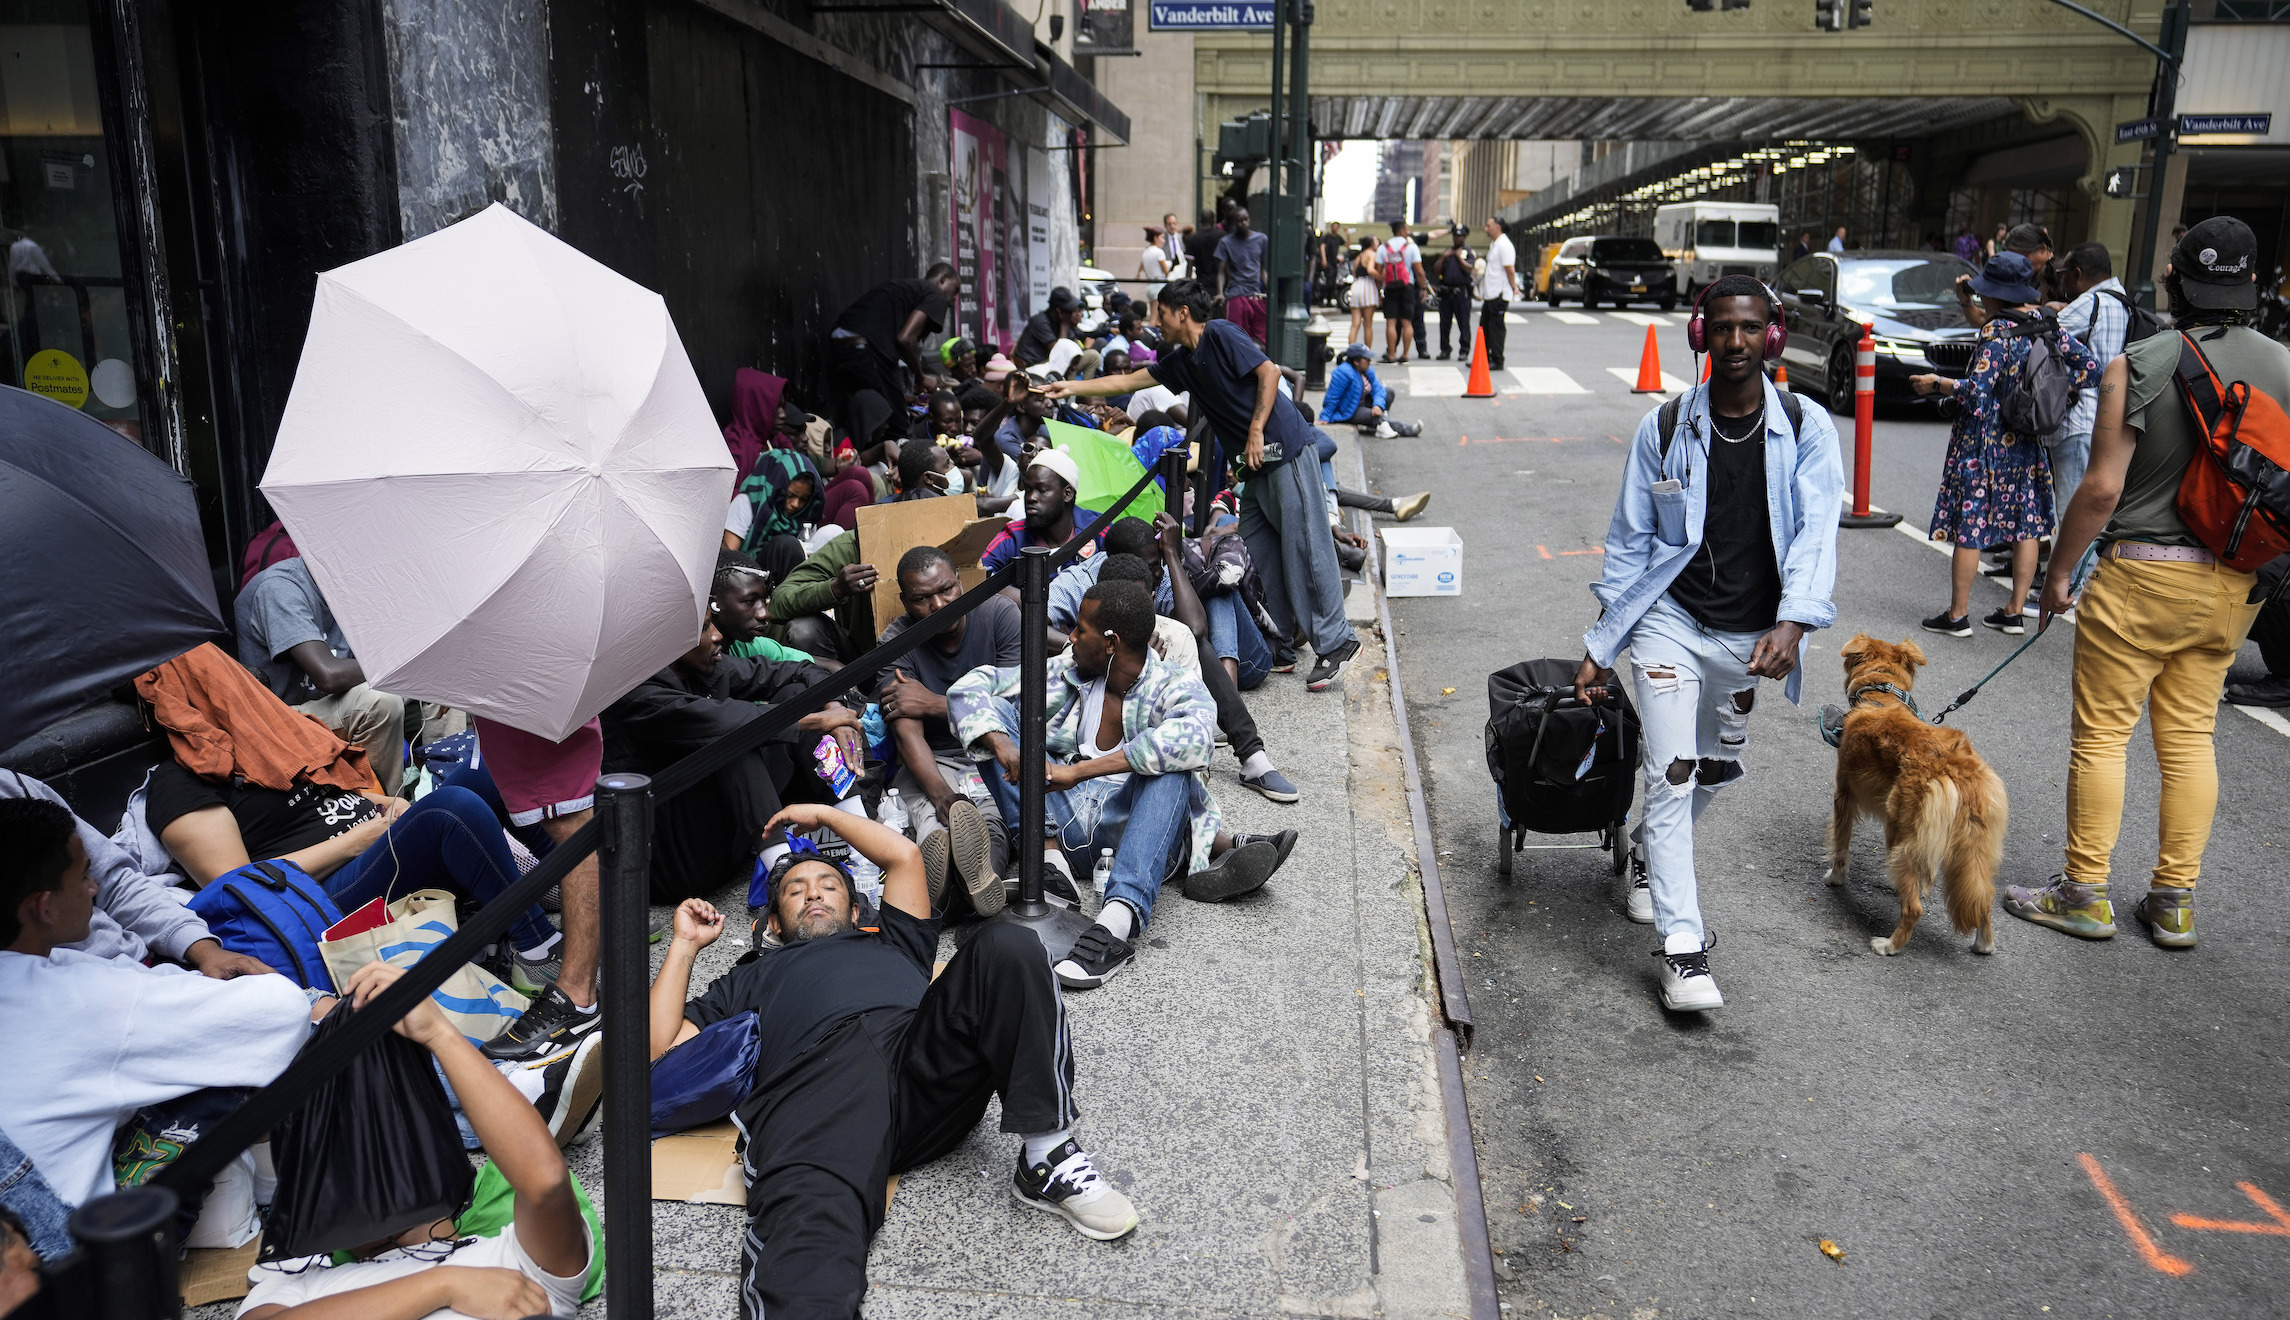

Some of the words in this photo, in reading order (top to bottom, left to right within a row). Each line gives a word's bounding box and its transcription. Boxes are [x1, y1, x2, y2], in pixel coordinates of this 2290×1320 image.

[1154, 5, 1239, 24] Vanderbilt
[1243, 6, 1274, 23] Ave
[2184, 118, 2241, 131] Vanderbilt
[2244, 118, 2266, 130] Ave
[31, 382, 83, 395] Postmates
[288, 793, 302, 807] as
[303, 782, 314, 796] yo
